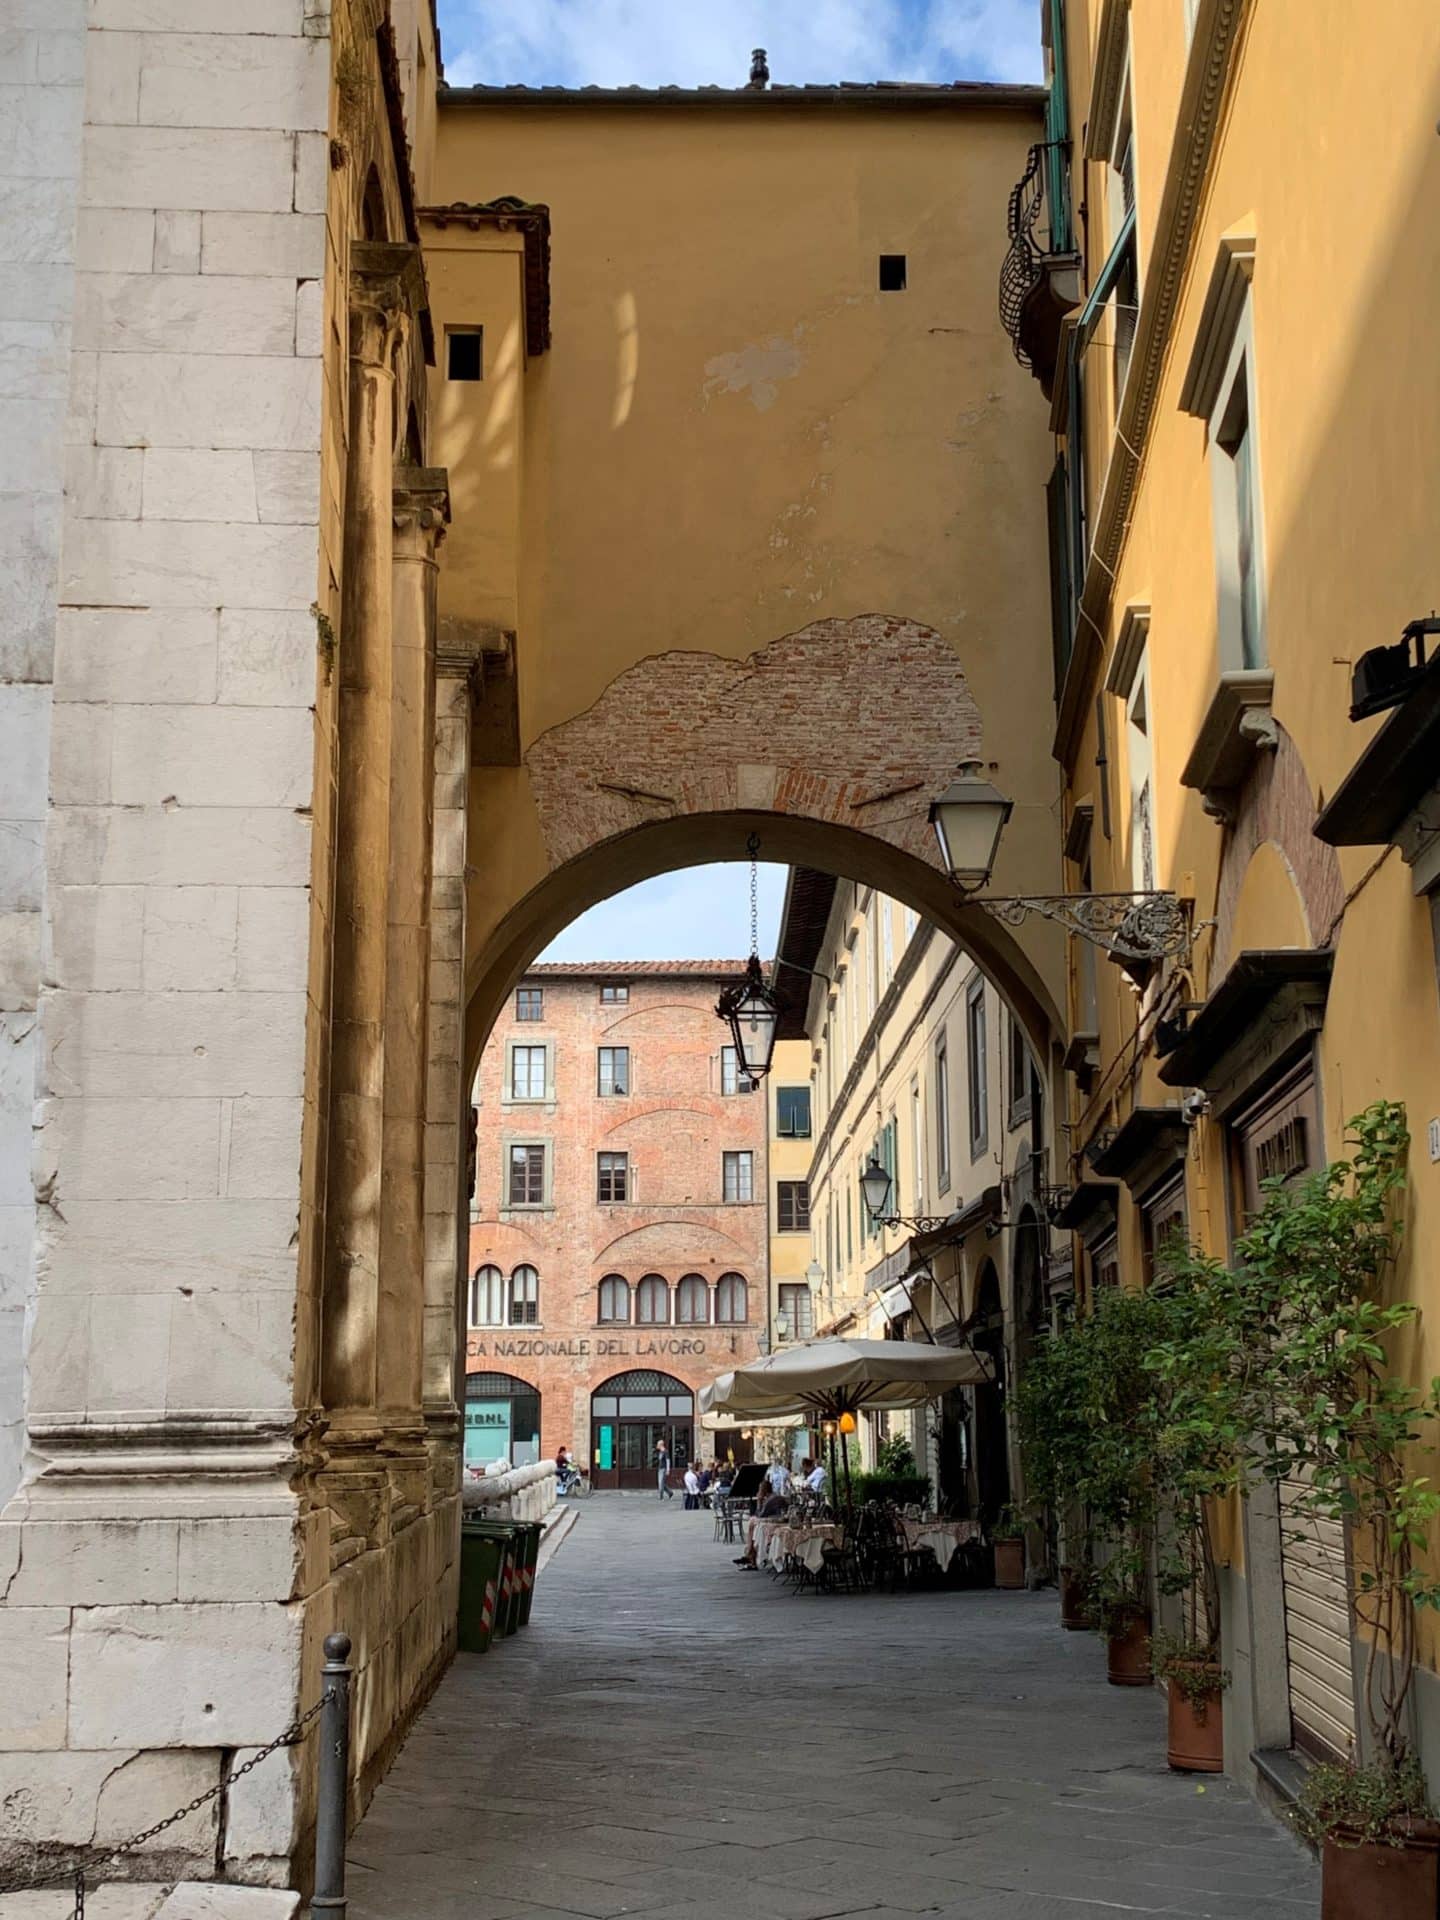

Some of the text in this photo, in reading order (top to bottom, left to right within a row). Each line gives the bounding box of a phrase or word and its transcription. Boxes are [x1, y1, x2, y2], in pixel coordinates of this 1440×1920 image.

[495, 1340, 590, 1356] NAZIONALE
[597, 1339, 629, 1355] DEL
[637, 1339, 705, 1355] LAVORO
